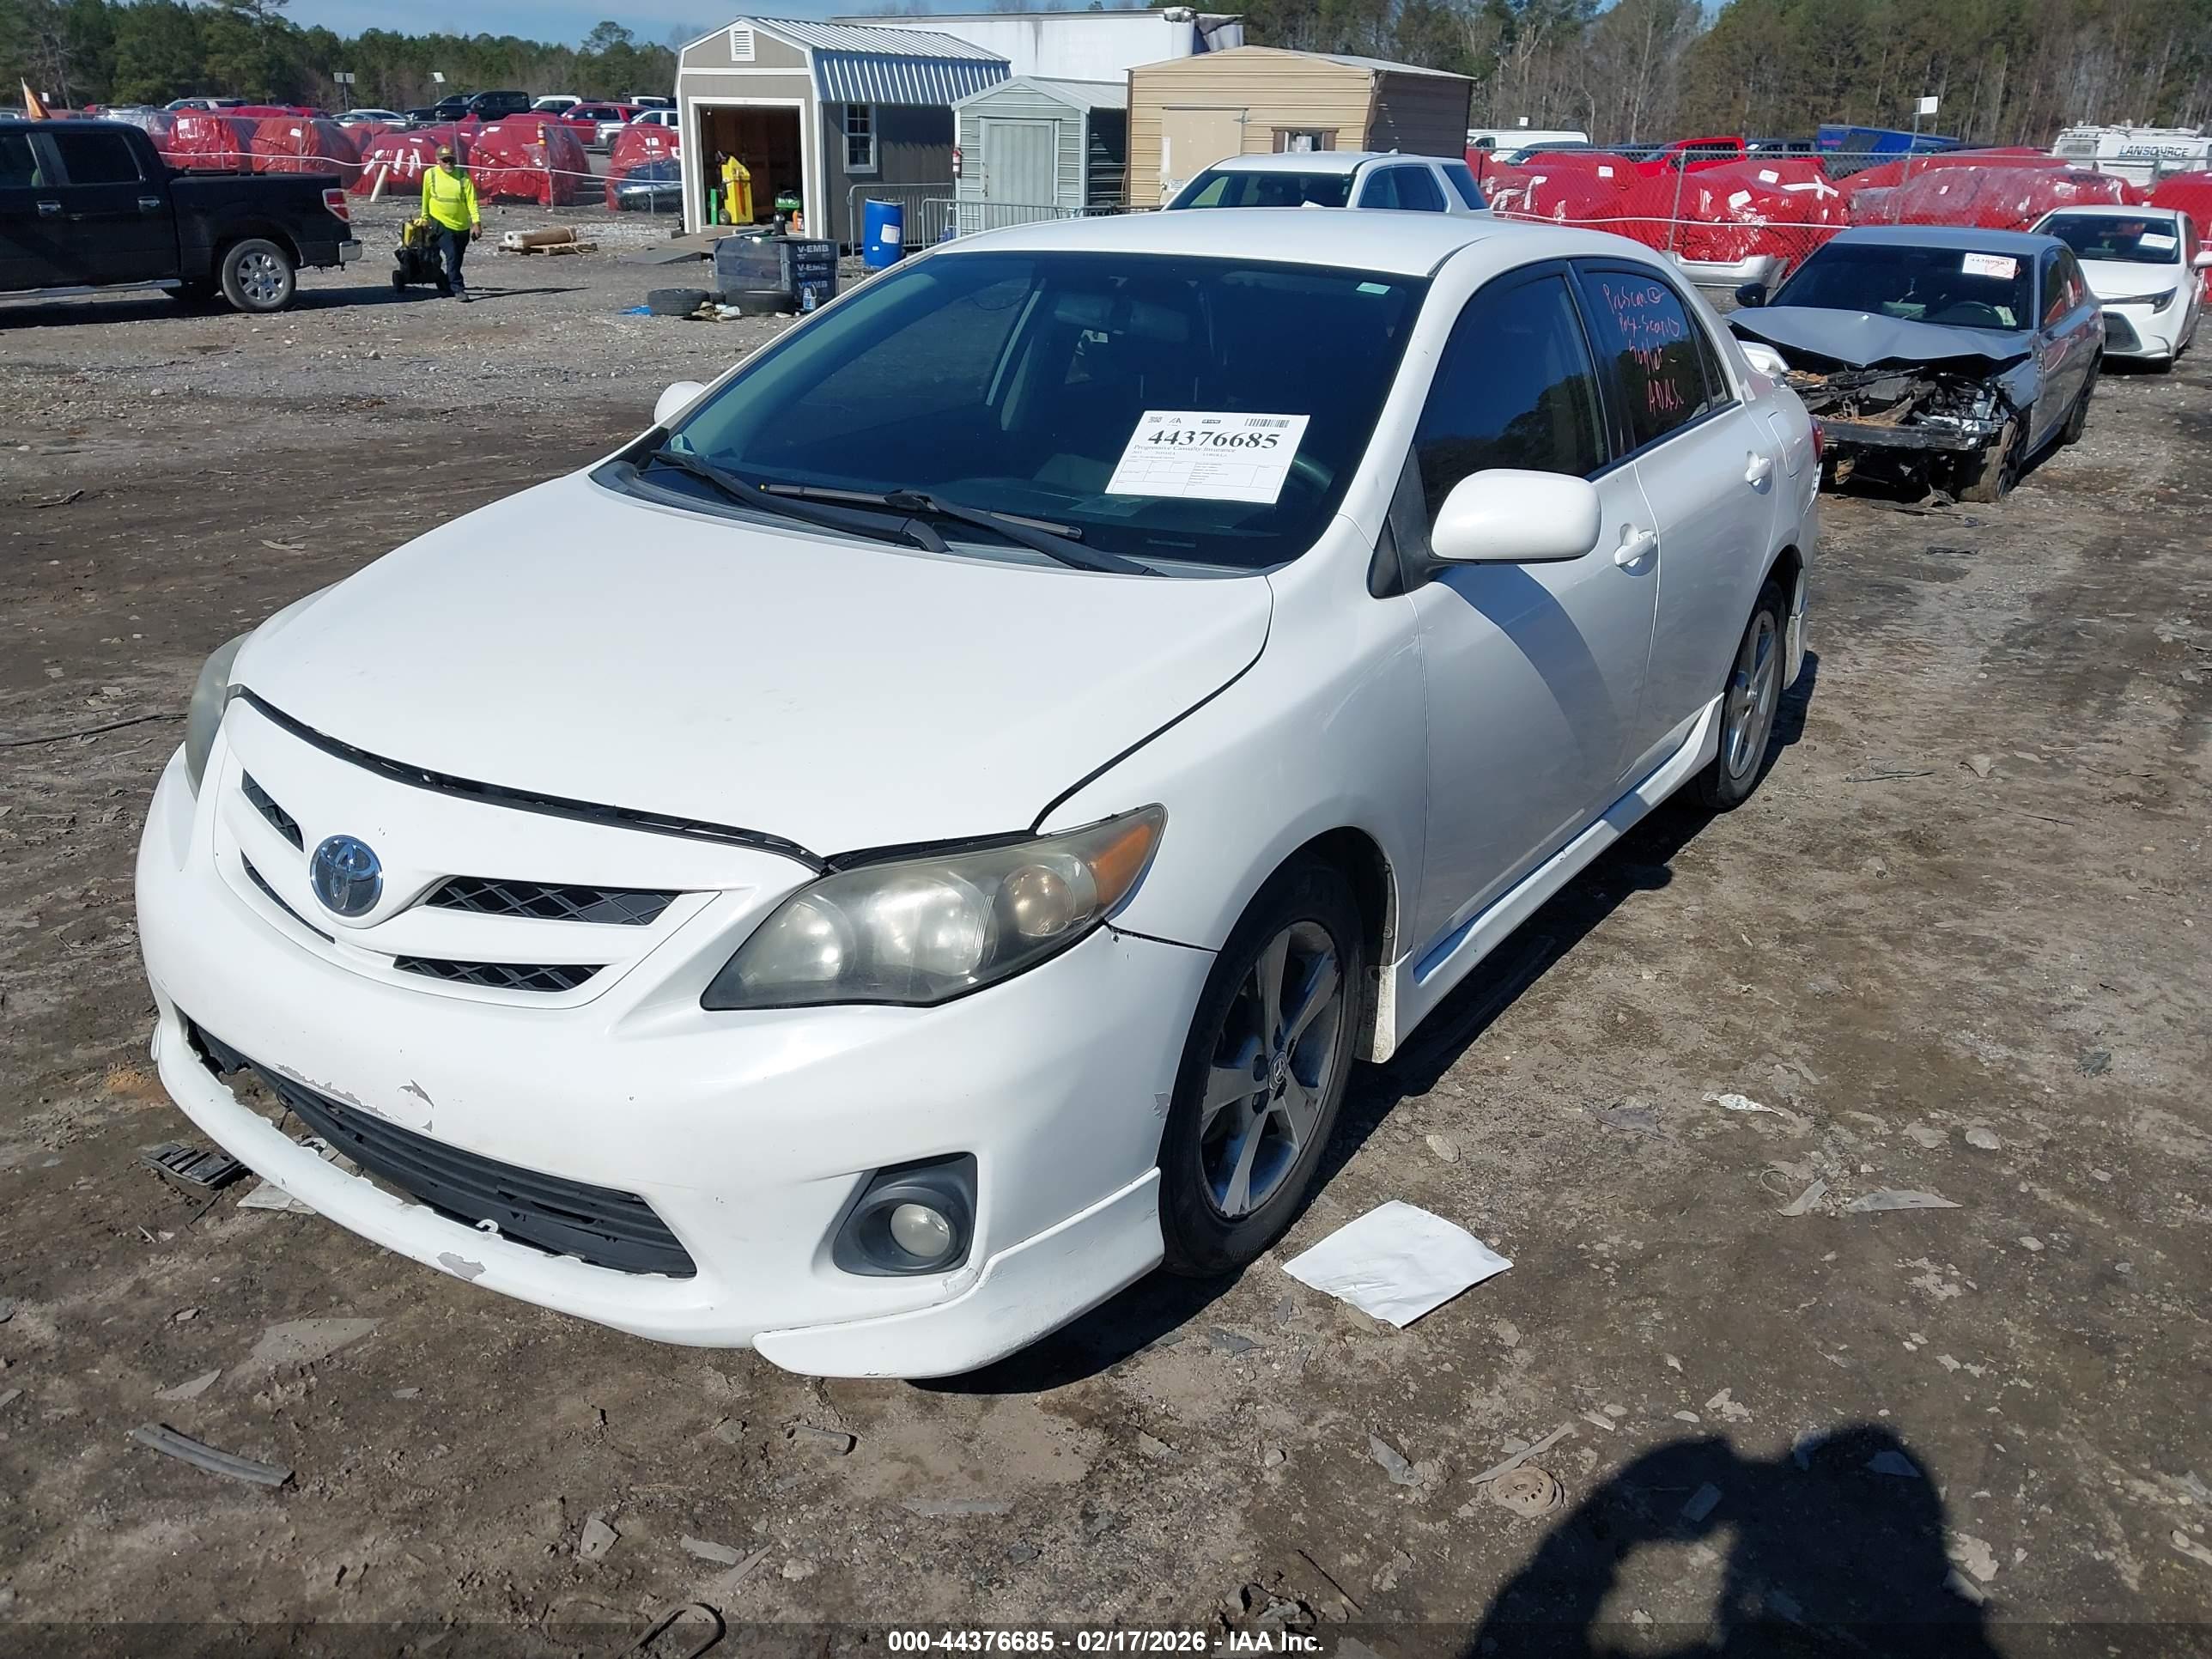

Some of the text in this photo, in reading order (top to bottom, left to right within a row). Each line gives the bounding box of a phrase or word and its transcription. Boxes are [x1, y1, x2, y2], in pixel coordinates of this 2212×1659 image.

[2119, 144, 2191, 156] LANSOURCE
[797, 244, 830, 252] V-EMB
[1147, 429, 1281, 449] 44376685
